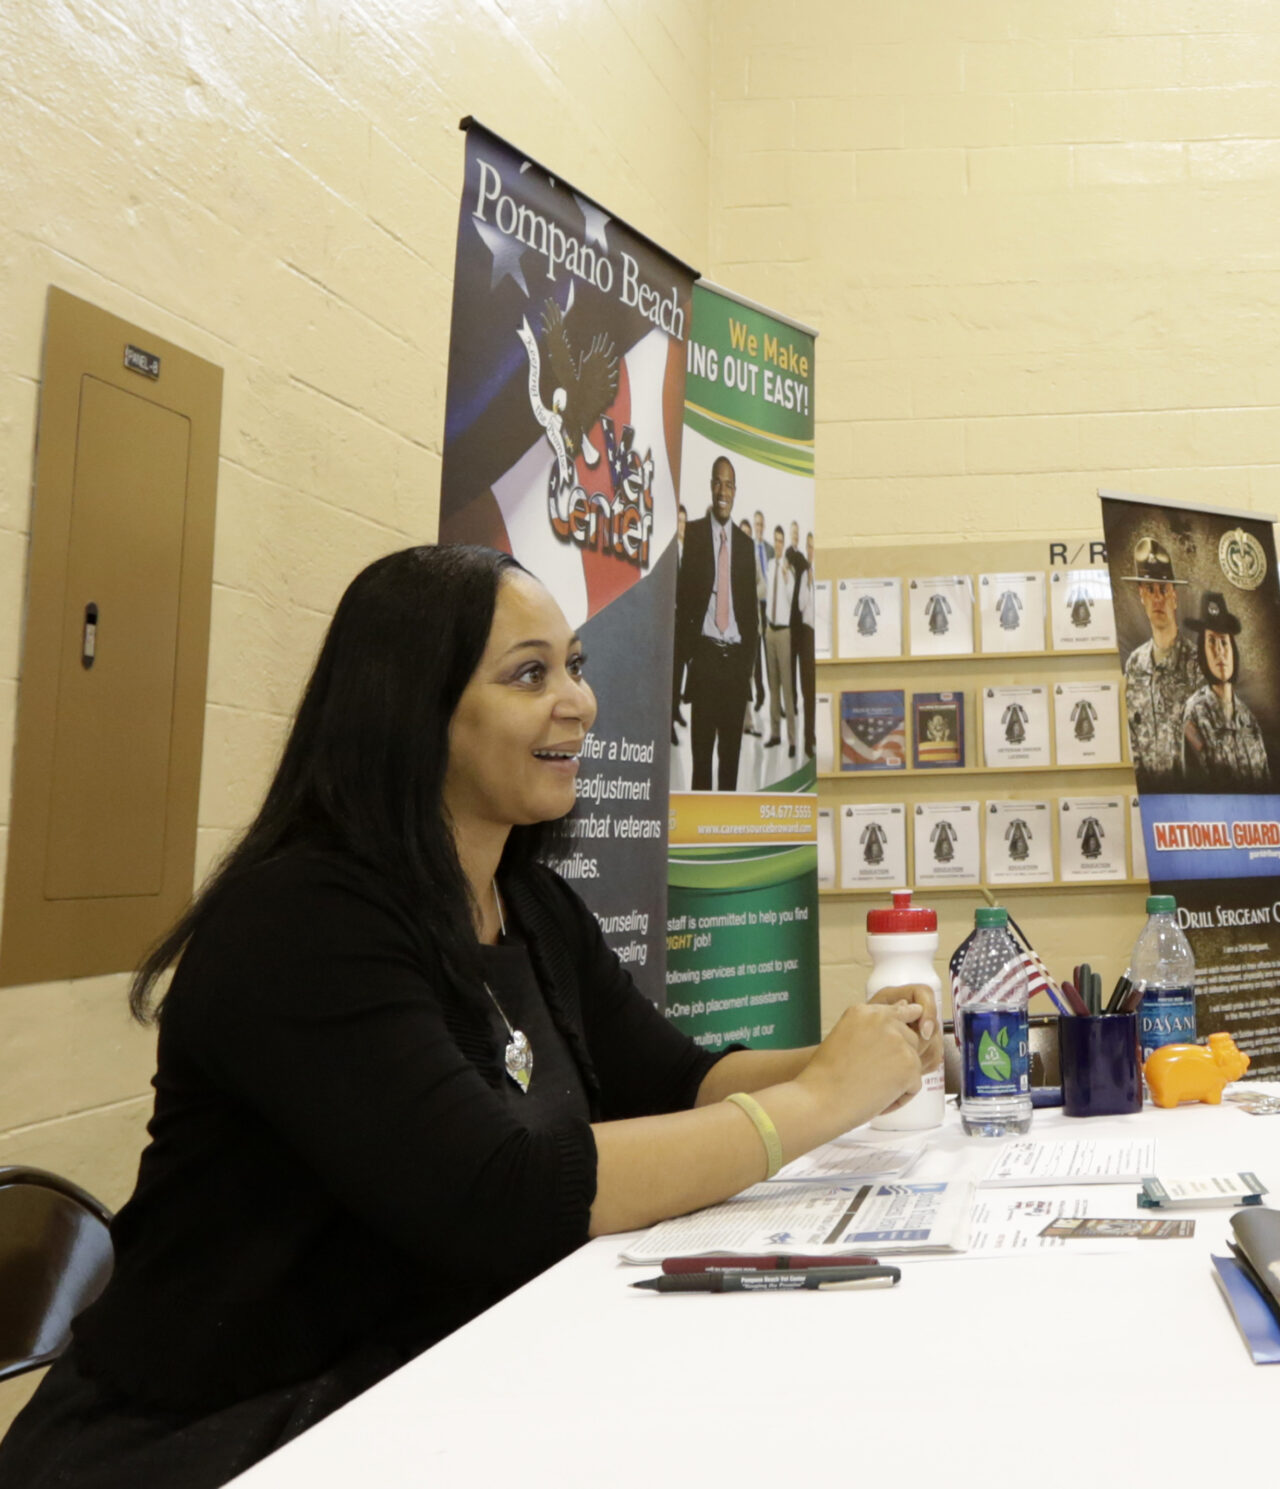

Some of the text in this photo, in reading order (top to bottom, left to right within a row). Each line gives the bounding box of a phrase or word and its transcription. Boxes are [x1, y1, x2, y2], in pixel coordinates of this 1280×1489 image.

[472, 157, 684, 341] Pompano Beach
[728, 317, 808, 378] We Make
[724, 355, 759, 396] OUT
[764, 369, 808, 416] EASY!
[600, 413, 655, 511] Vet
[548, 454, 653, 570] Center
[609, 742, 616, 760] a
[621, 738, 654, 763] broad
[576, 774, 650, 805] eadjustment
[564, 813, 610, 838] mbat
[614, 815, 661, 838] veterans
[1154, 823, 1280, 848] NATIONAL GUARD
[593, 910, 648, 935] ounseling
[667, 907, 808, 931] staff is committed to help you find
[694, 933, 711, 951] job!
[666, 969, 700, 984] following
[691, 1001, 704, 1017] job
[706, 995, 748, 1015] placement
[750, 992, 789, 1006] assistance
[723, 1026, 750, 1040] weekly
[752, 1025, 760, 1037] at
[761, 1024, 774, 1035] our
[1143, 1014, 1195, 1034] DASANI
